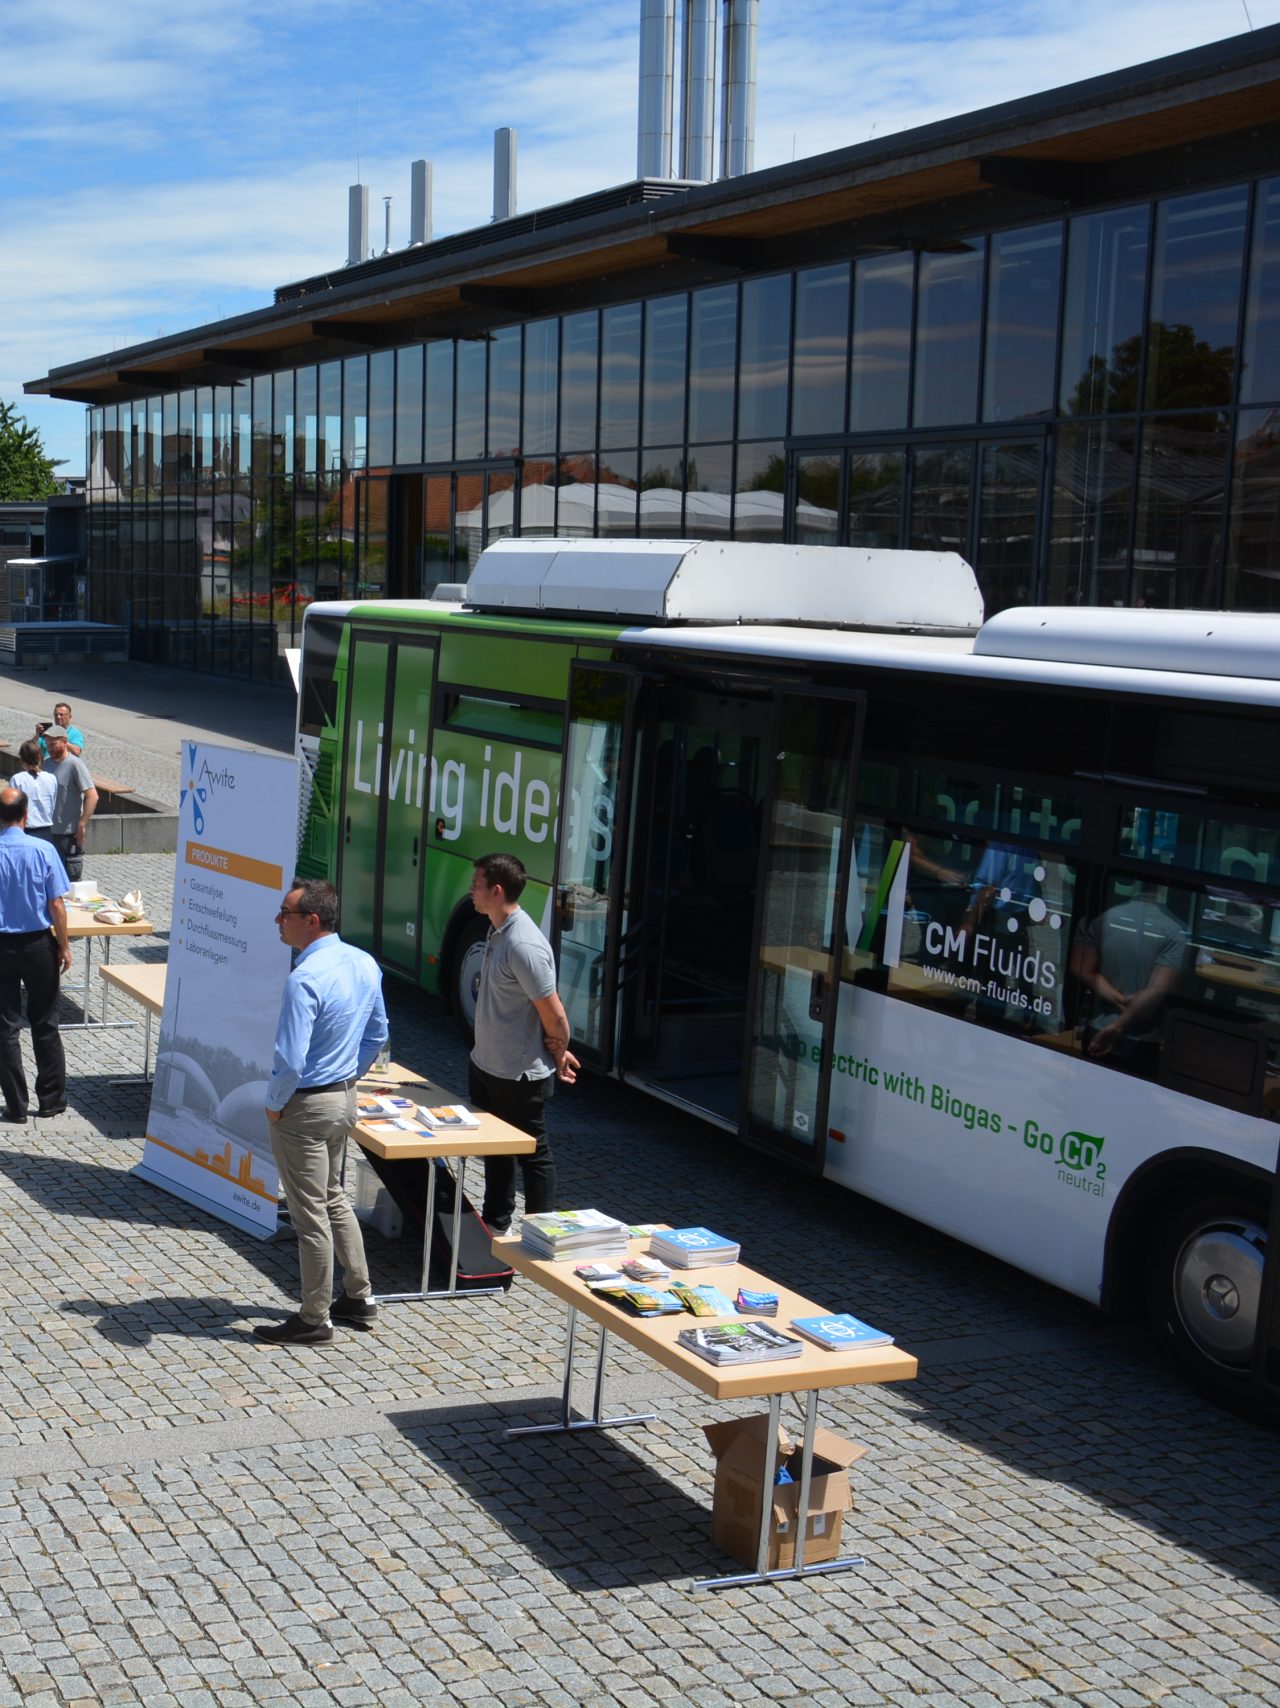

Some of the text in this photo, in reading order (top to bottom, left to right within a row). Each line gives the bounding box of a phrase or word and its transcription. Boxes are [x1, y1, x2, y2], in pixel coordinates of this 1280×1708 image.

[198, 759, 236, 795] Awite
[354, 720, 614, 862] Living ideas
[191, 848, 229, 869] PRODUKTE
[189, 878, 224, 899] Gasanalyse
[188, 898, 238, 928] Entschwefelung
[187, 918, 248, 953] Durchflussmessung
[185, 939, 228, 965] Laboranlagen
[925, 921, 1057, 989] CM Fluids
[922, 964, 1053, 1016] www.cm-fluids.de
[883, 1071, 926, 1105] with
[930, 1084, 1002, 1133] Biogas
[1023, 1119, 1054, 1155] Go
[1057, 1168, 1105, 1198] neutral
[232, 1192, 261, 1212] awite.de
